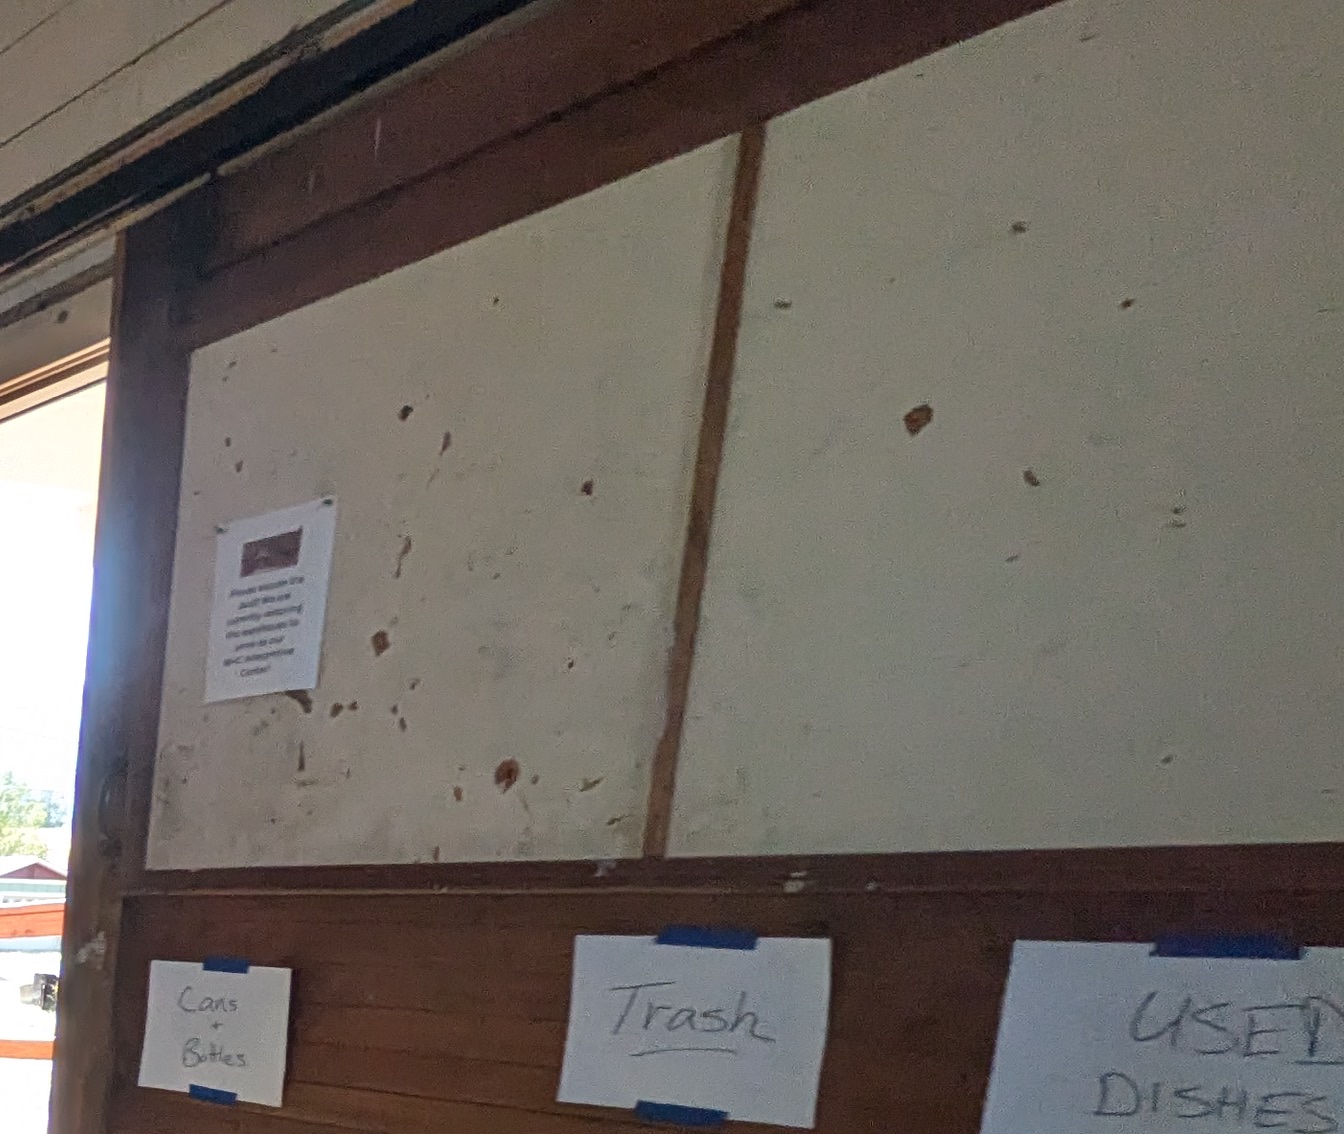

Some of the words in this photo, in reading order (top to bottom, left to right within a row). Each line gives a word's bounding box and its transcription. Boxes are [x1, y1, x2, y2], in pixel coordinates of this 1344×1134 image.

[177, 985, 239, 1012] Cans
[609, 980, 777, 1043] Trash
[182, 1037, 247, 1068] Bottles
[1092, 1071, 1339, 1134] DISHES
